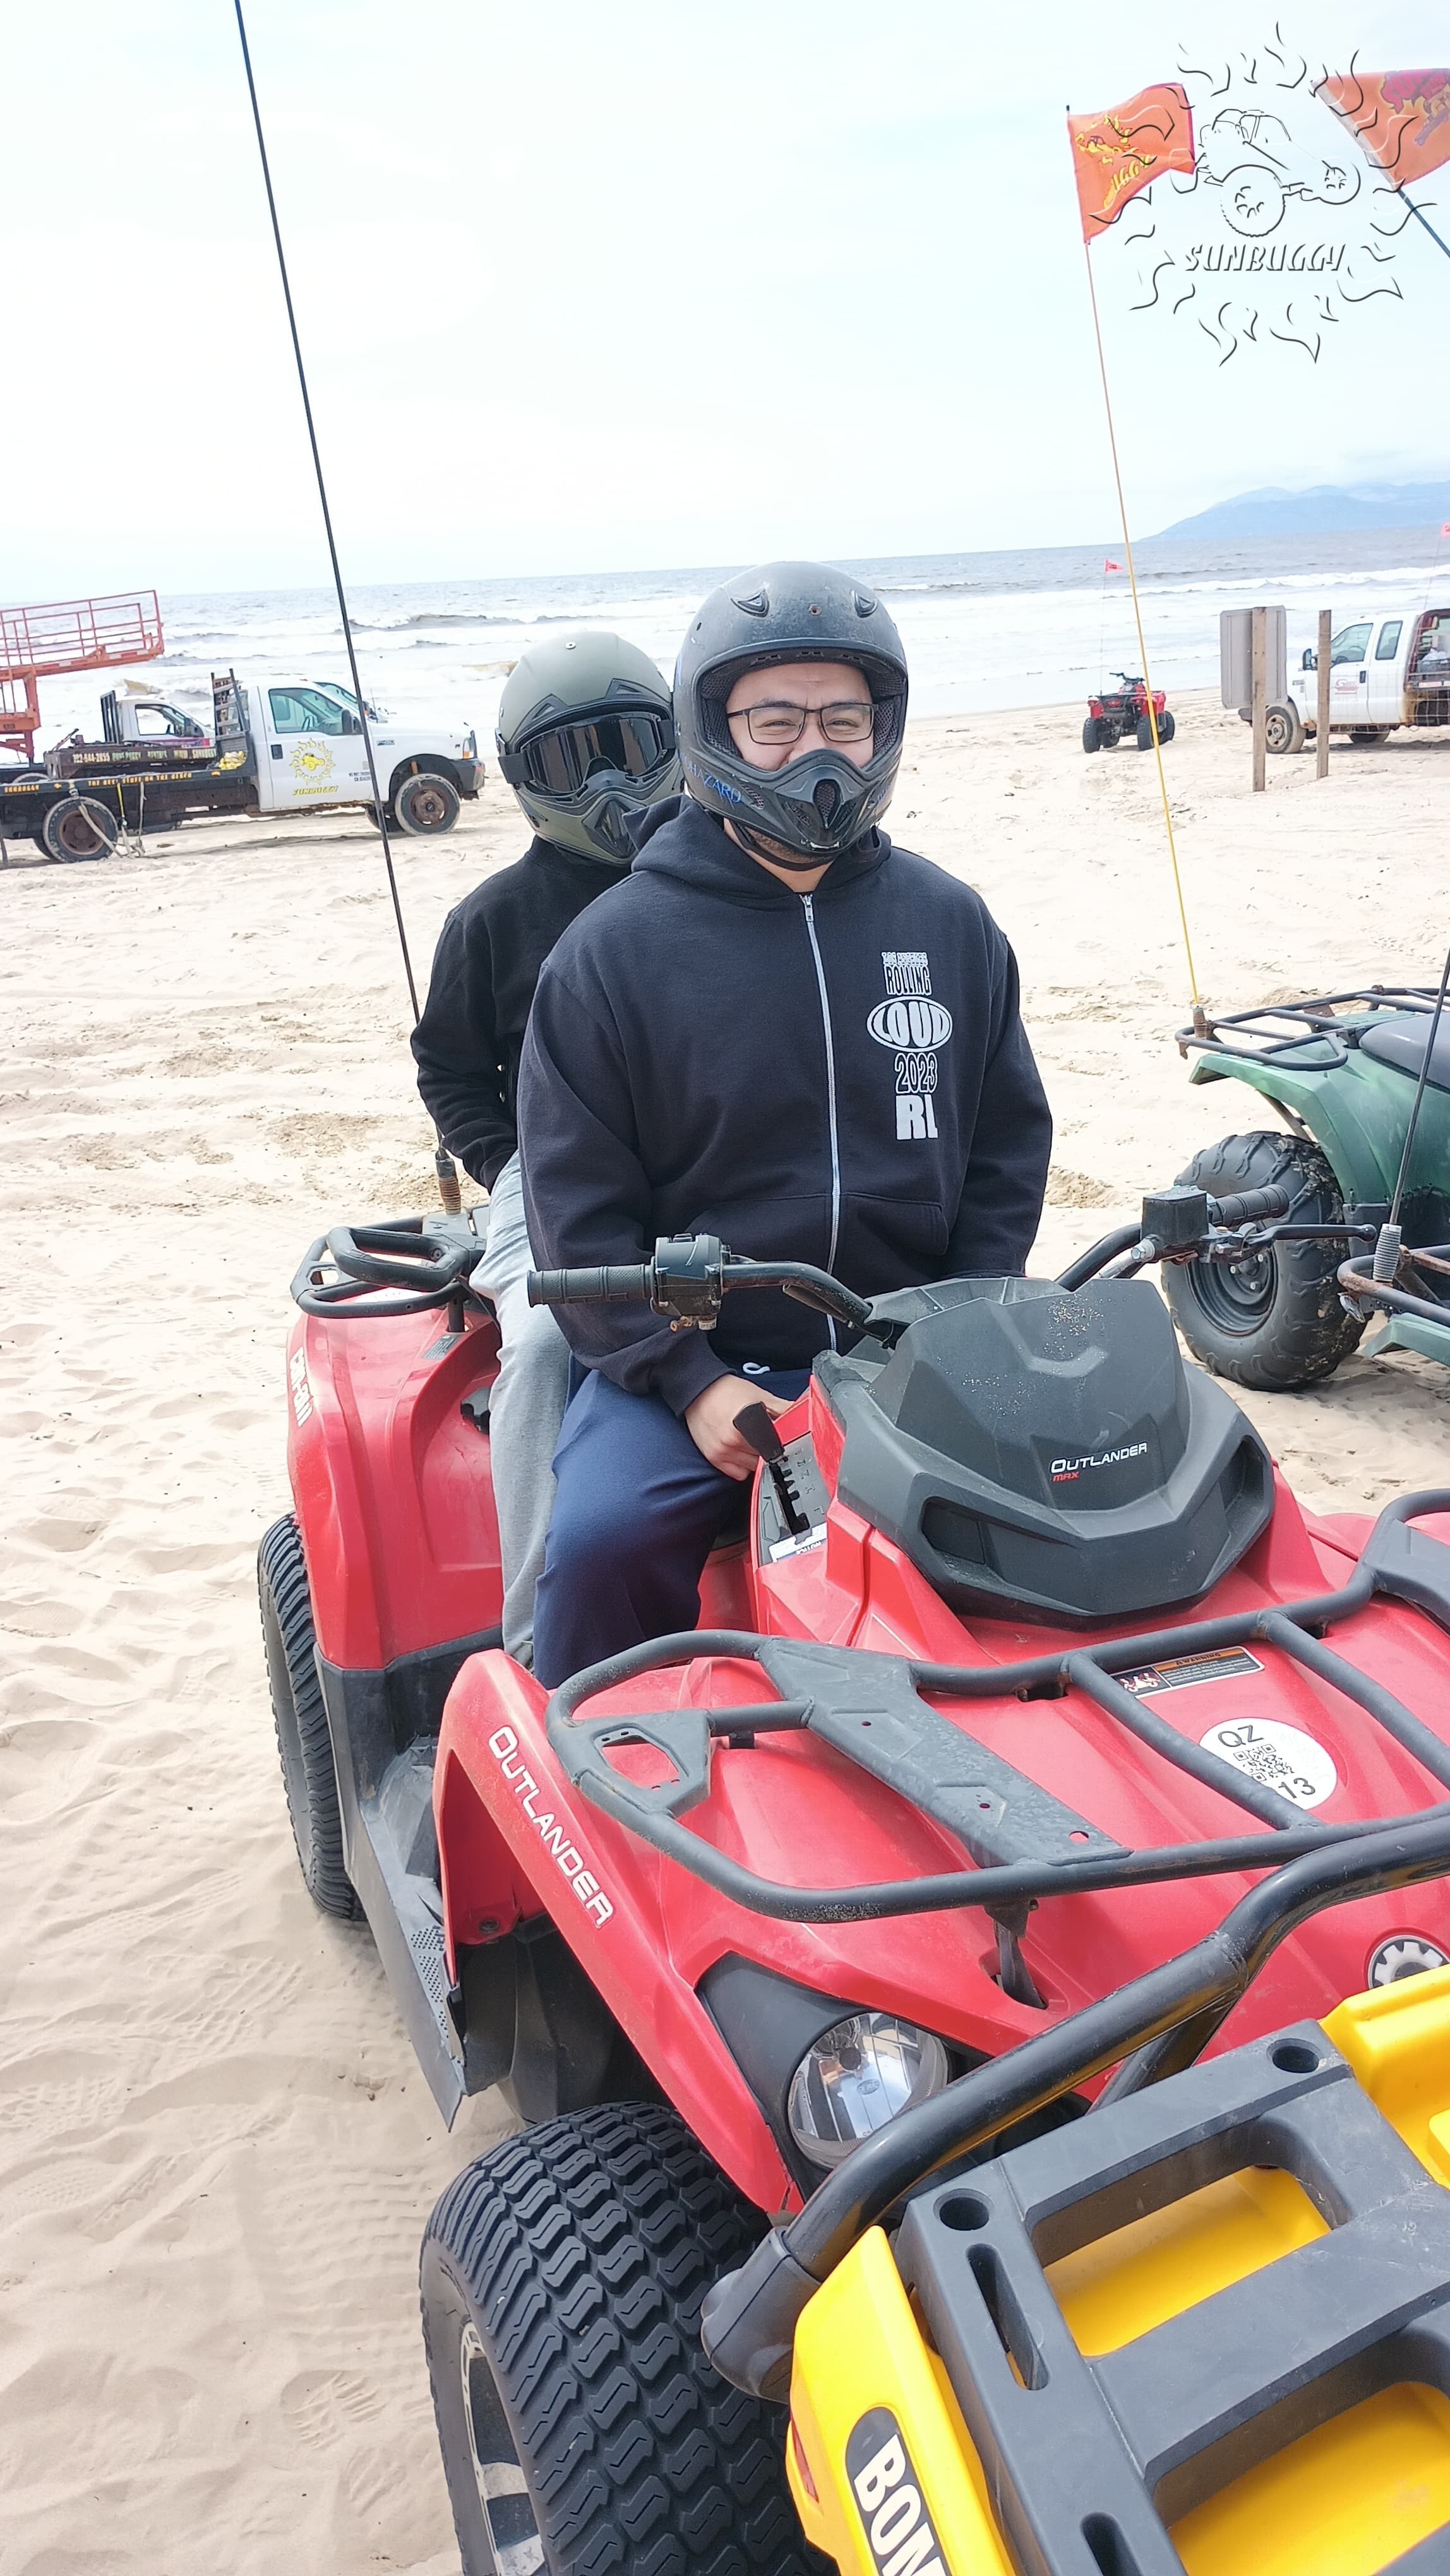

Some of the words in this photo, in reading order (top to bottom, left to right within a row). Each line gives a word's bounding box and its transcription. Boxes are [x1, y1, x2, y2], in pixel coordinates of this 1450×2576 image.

[884, 965, 932, 996] ROLLING
[873, 1001, 948, 1047] LOUD
[894, 1052, 938, 1094] 2023
[1051, 1442, 1147, 1474] OUTLANDER
[1218, 1725, 1264, 1748] QZ
[1278, 1777, 1316, 1799] 13
[489, 1725, 614, 1929] OUTLANDER
